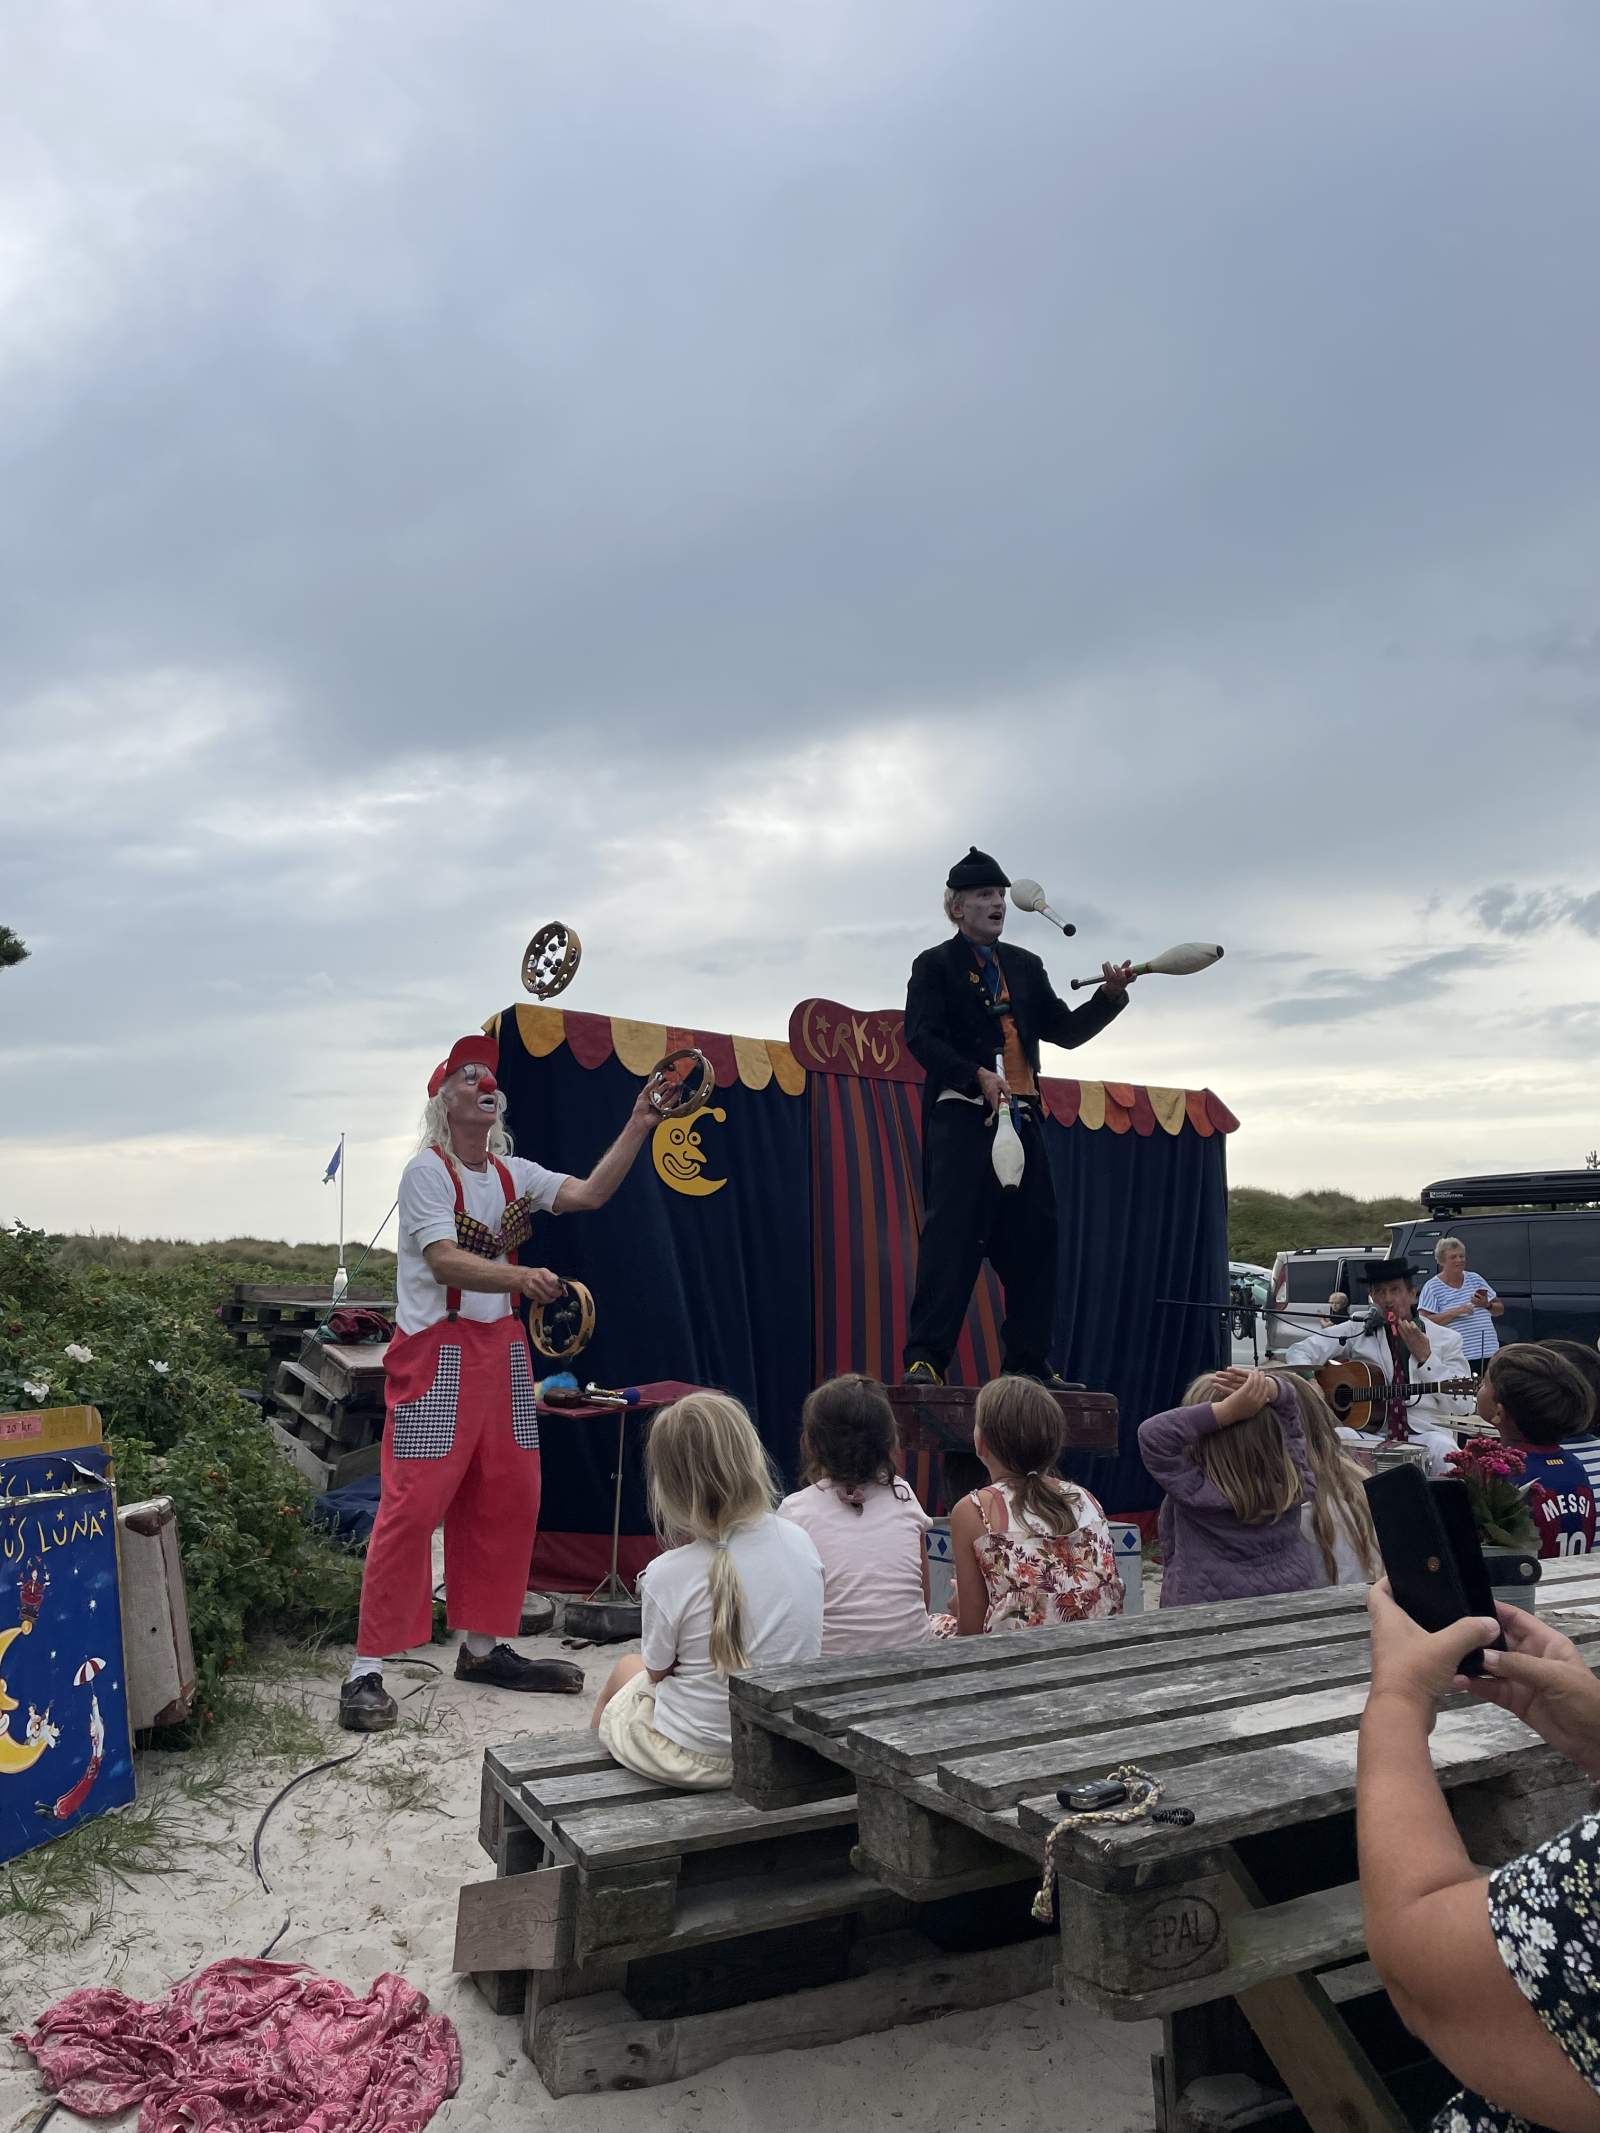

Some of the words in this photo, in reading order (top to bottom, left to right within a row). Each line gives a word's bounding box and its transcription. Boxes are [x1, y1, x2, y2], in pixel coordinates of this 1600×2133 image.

[6, 1424, 17, 1434] 20
[21, 1420, 33, 1431] kr.
[1541, 1493, 1590, 1522] MESSI
[0, 1516, 27, 1563] US
[37, 1511, 104, 1554] LUNA
[1147, 1909, 1209, 1957] EPAL
